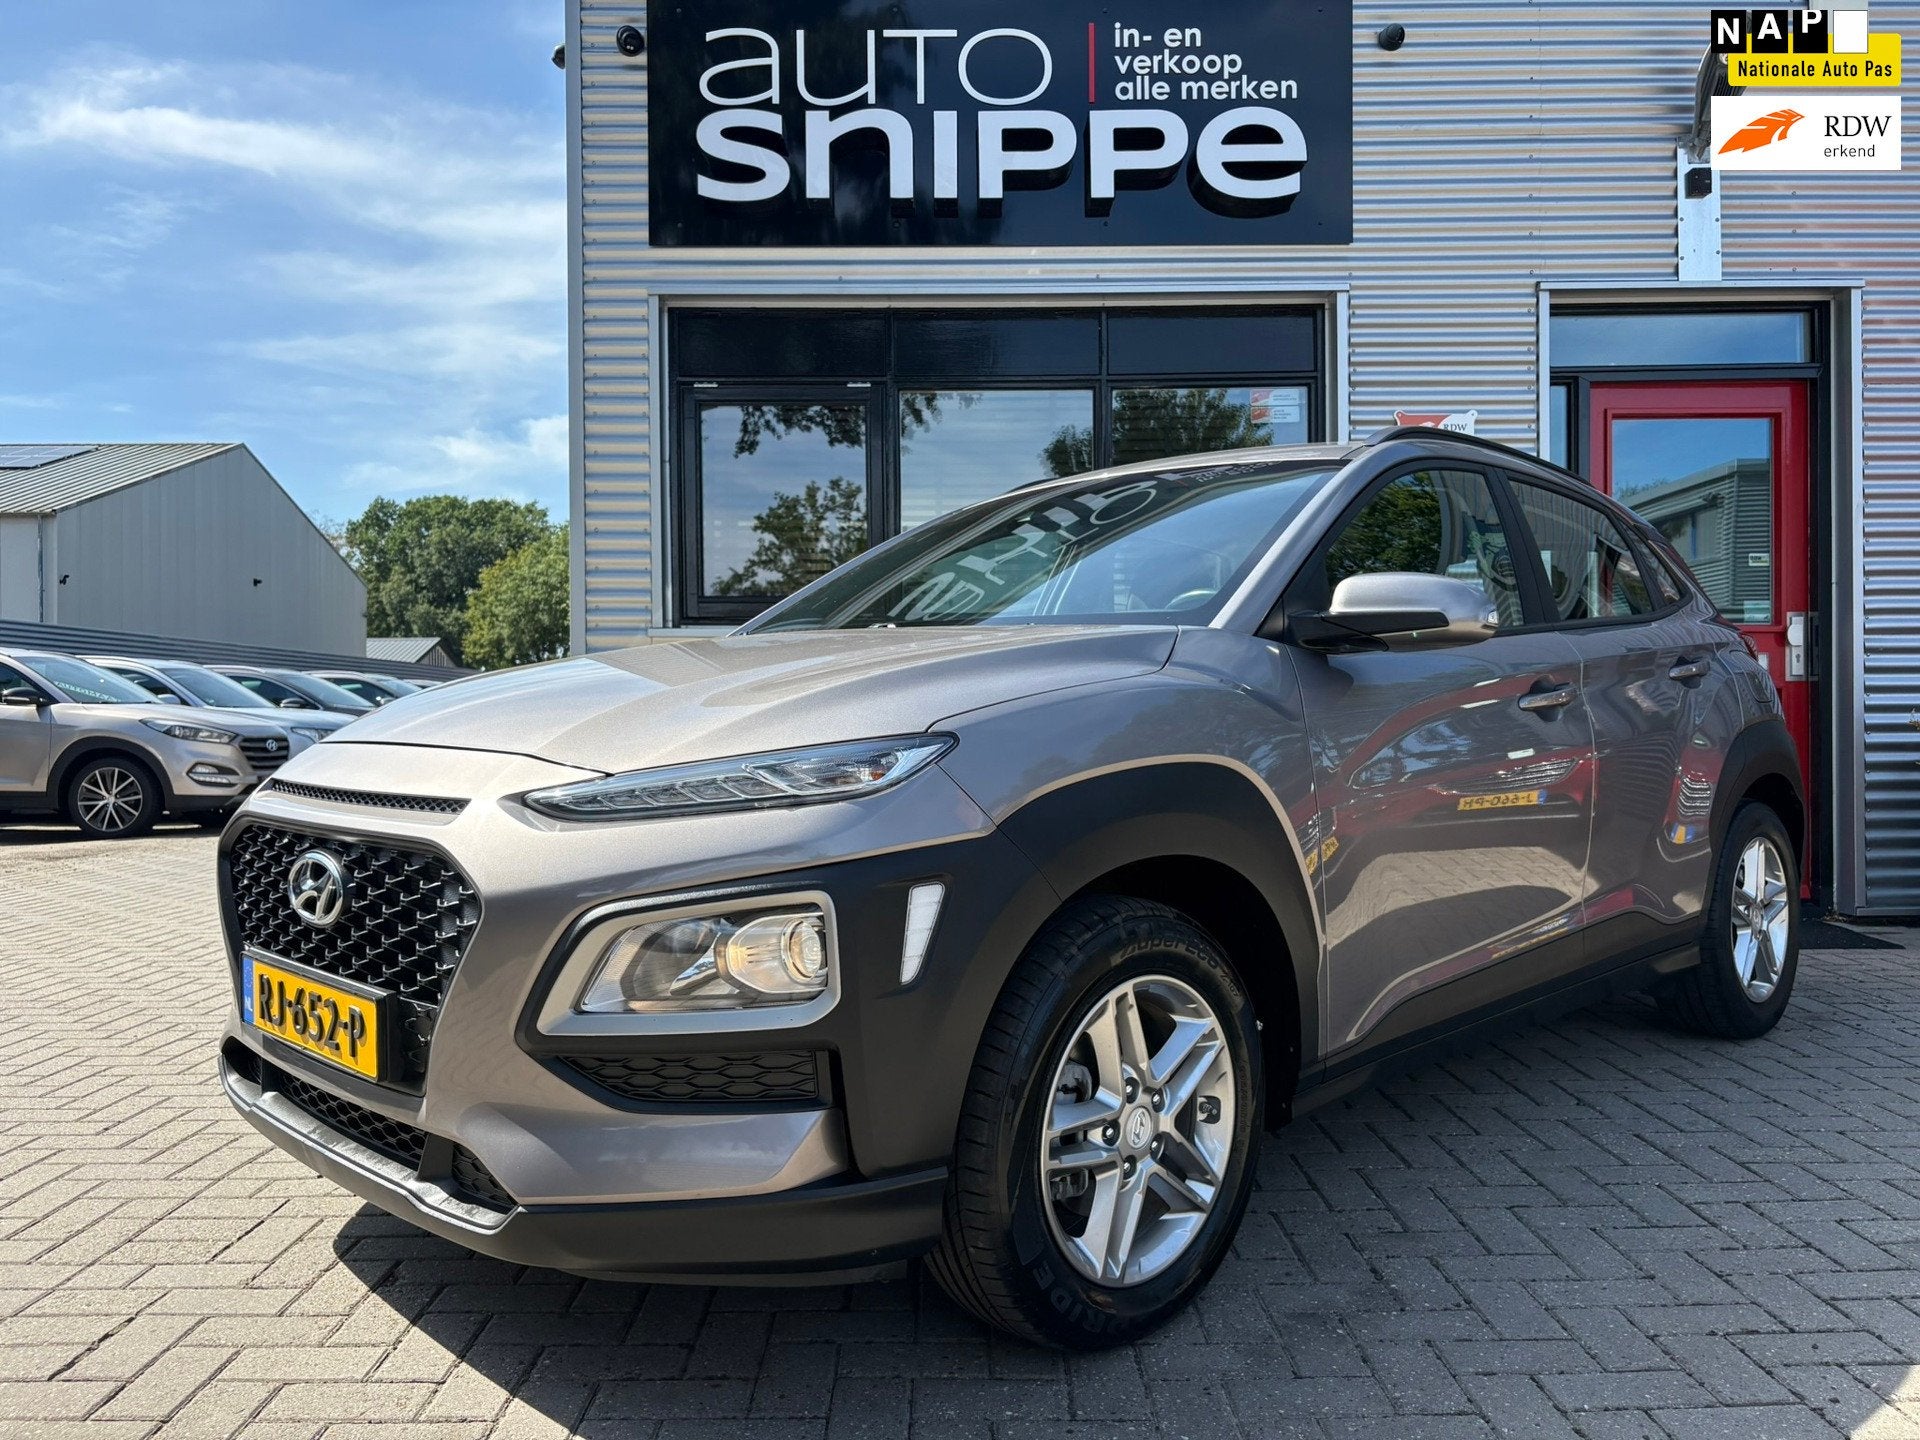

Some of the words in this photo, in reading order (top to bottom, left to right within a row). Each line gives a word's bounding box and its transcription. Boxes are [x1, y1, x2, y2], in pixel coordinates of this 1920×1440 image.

[1114, 23, 1153, 49] in-
[1163, 27, 1202, 49] en
[1114, 50, 1243, 78] verkoop
[1114, 75, 1175, 101] alle
[1180, 74, 1299, 101] merken
[1443, 422, 1468, 432] RDW
[260, 974, 365, 1058] RJ-652-P
